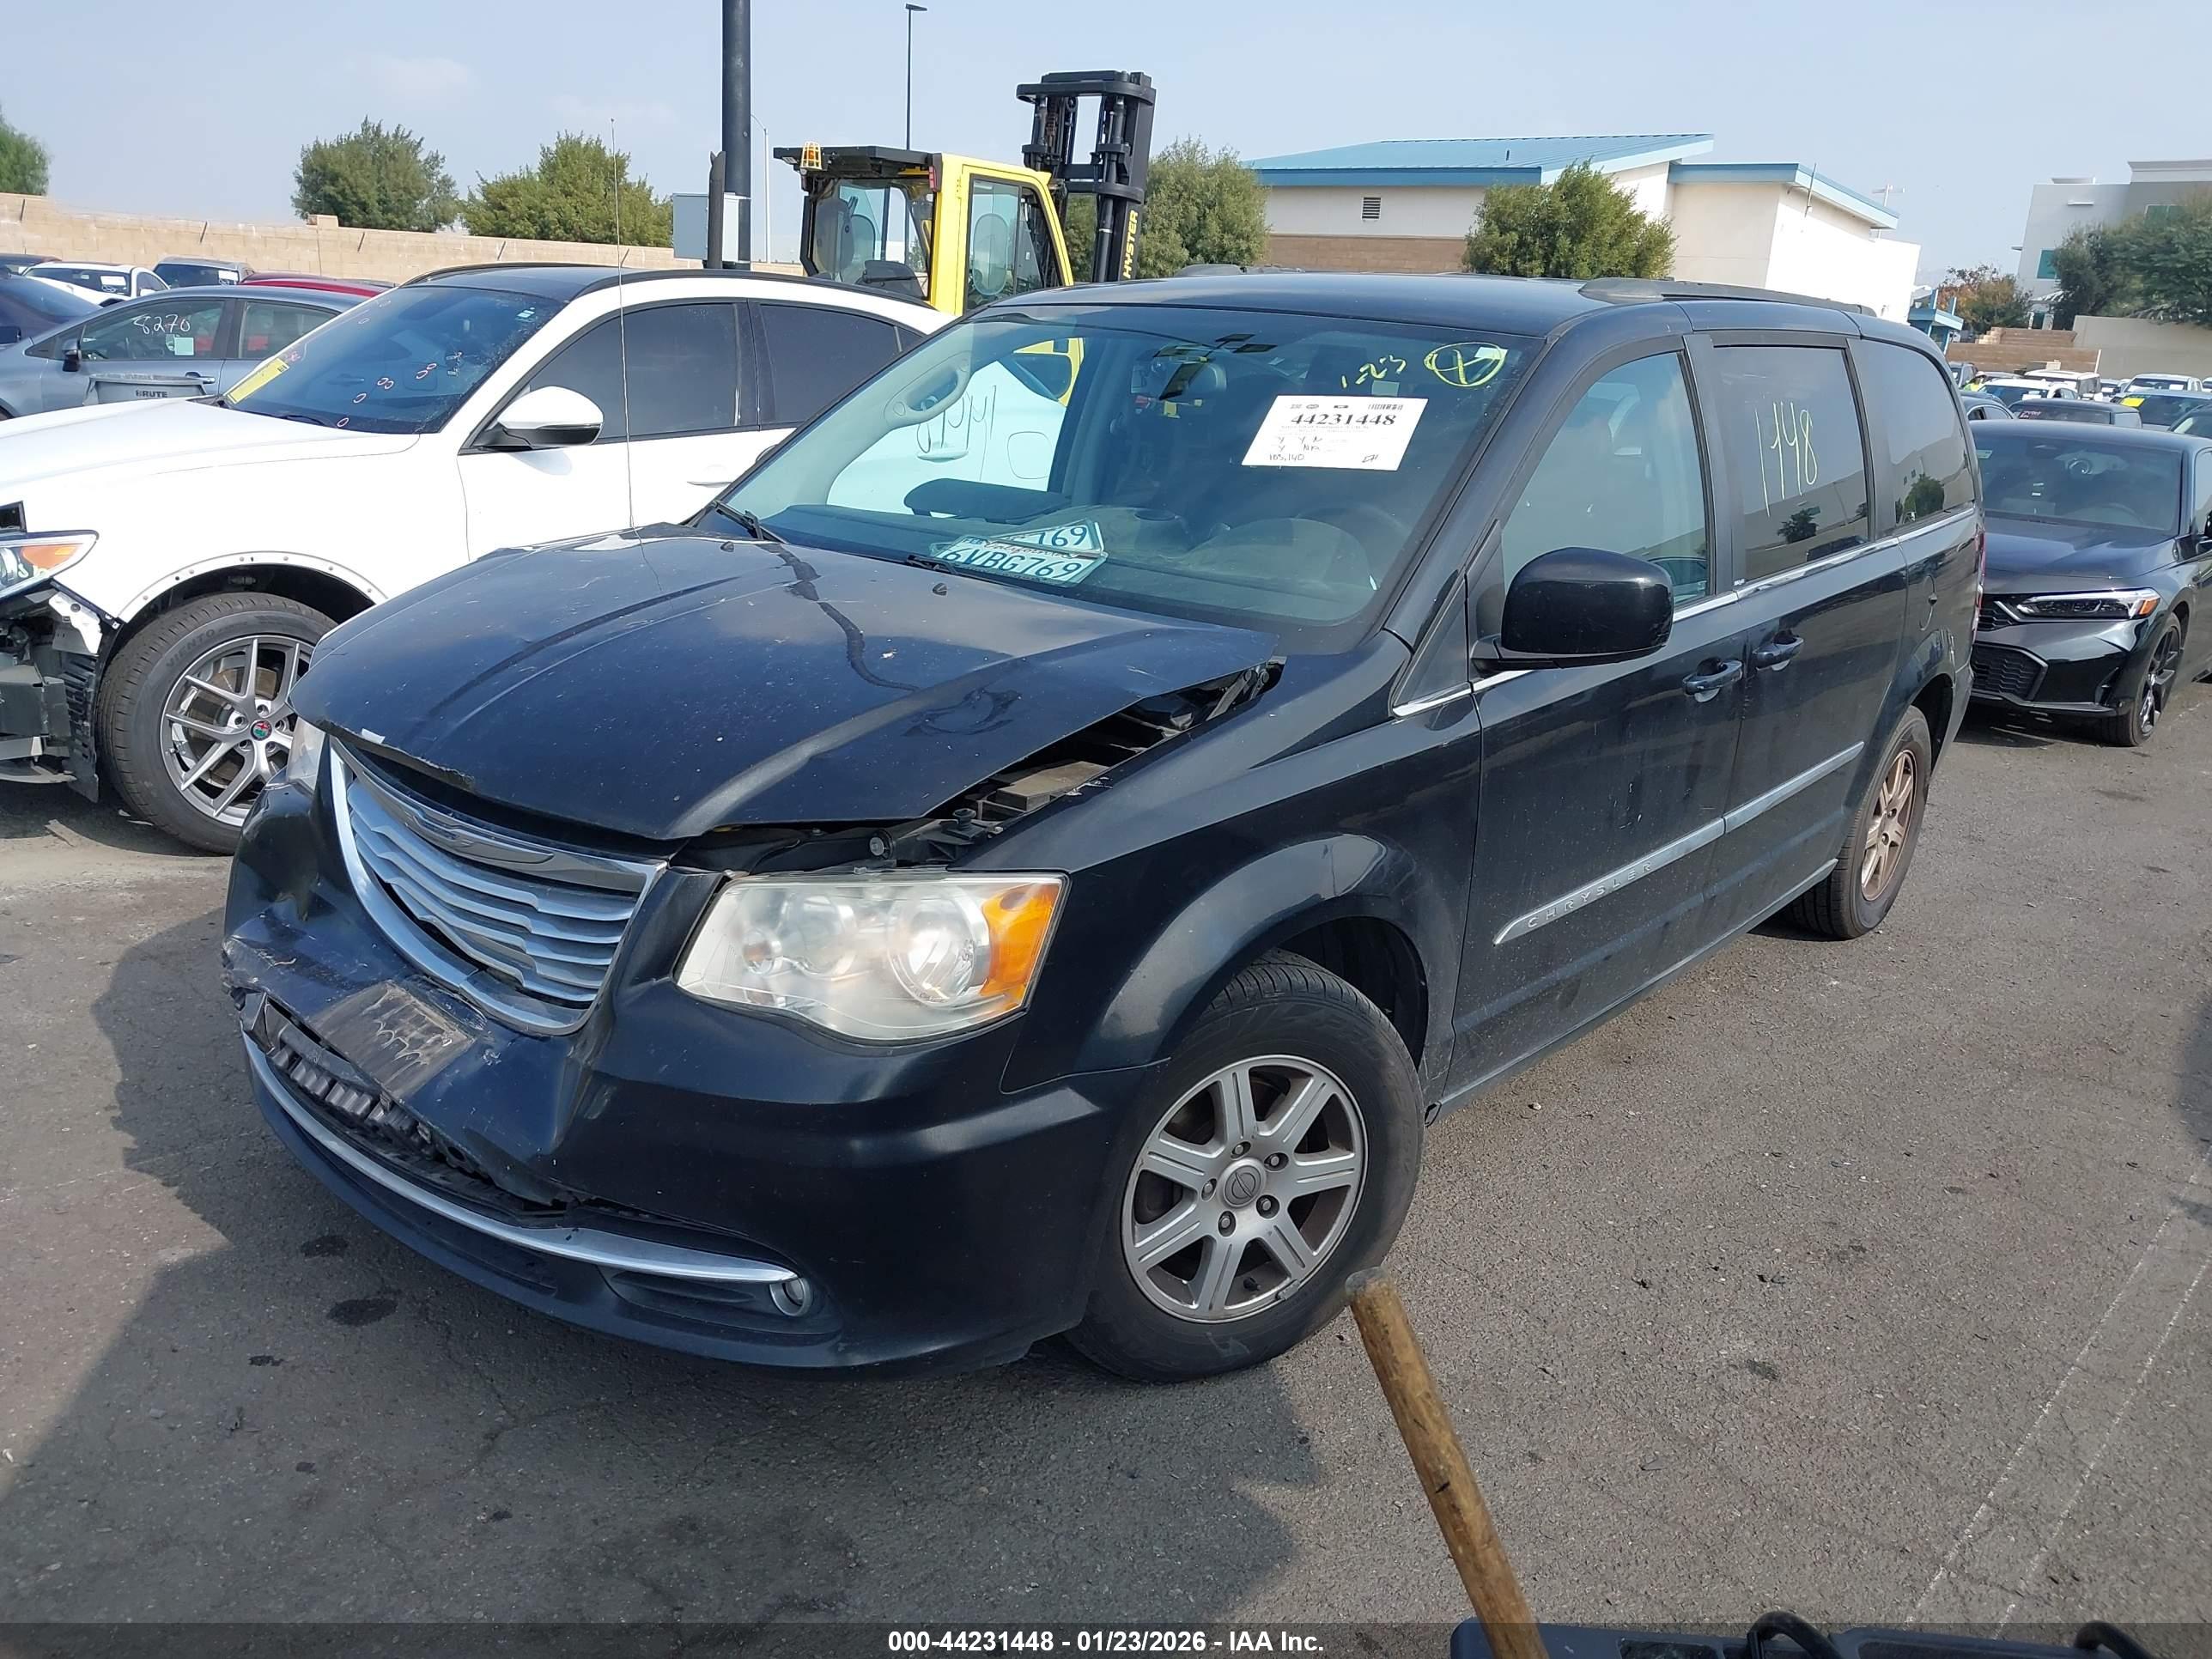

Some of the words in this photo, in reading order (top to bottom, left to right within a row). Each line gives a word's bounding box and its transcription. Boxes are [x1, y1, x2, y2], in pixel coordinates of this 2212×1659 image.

[1122, 210, 1139, 279] HYSTER
[133, 313, 191, 334] 8270
[135, 389, 168, 398] BRUTE
[1291, 414, 1397, 426] 44231448
[944, 548, 1083, 579] 6VBG769
[1528, 861, 1651, 928] CHRYSLER
